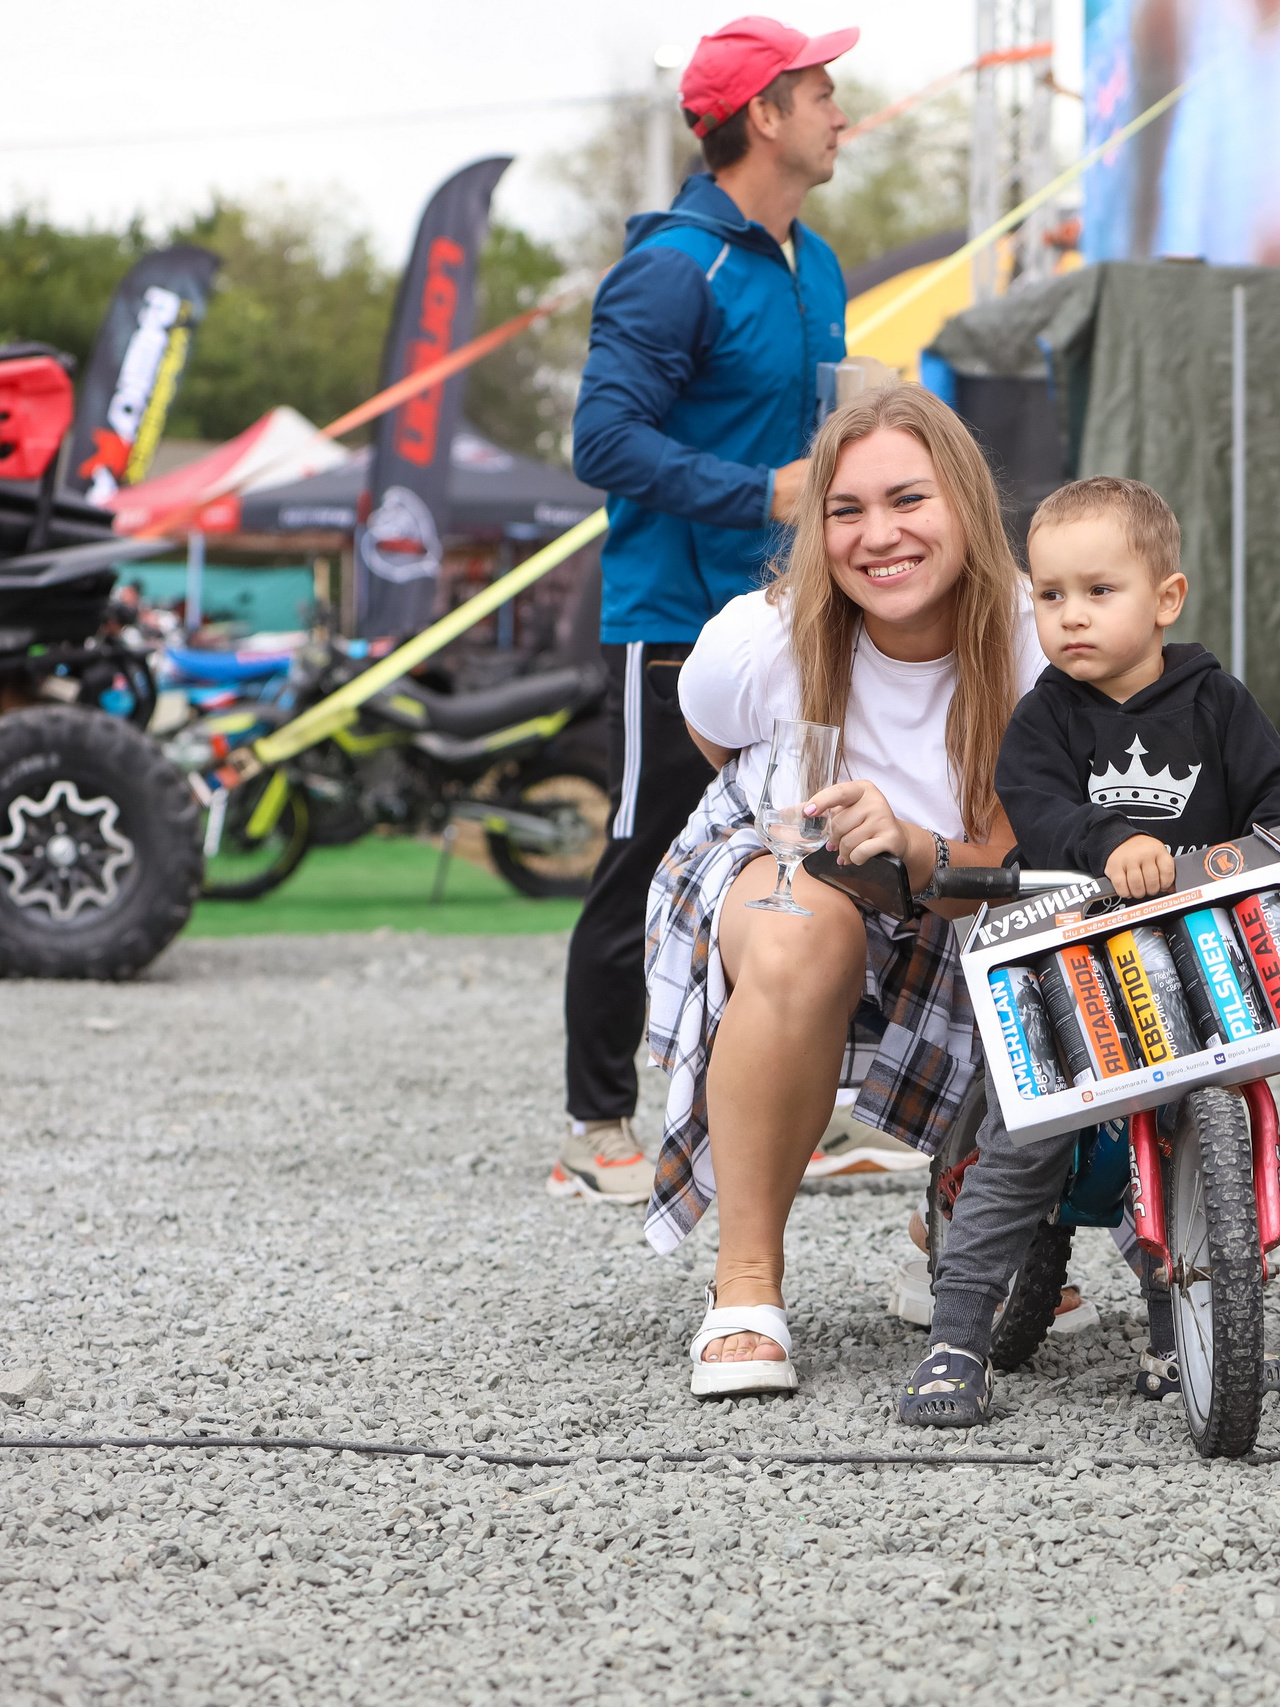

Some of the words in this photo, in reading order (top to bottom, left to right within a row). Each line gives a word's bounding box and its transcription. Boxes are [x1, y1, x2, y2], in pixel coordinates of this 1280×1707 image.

[978, 880, 1101, 945] КУЗНИЦА
[1088, 921, 1105, 931] чём
[1107, 914, 1128, 926] себе
[1143, 891, 1200, 914] отказывай!
[1241, 907, 1273, 955] ALE
[1070, 955, 1124, 1074] ЯНТАРНОЕ
[1087, 955, 1116, 1021] oktoberfest
[1117, 949, 1168, 1063] СВЕТЛОЕ
[1197, 931, 1250, 1040] PILSNER
[990, 980, 1036, 1099] AMERICAN
[1151, 993, 1180, 1057] классика
[1228, 1042, 1271, 1059] @pivo_kuznica
[1095, 1079, 1148, 1097] kuznicasamara.ru
[1166, 1060, 1209, 1077] @pivo_kuznica
